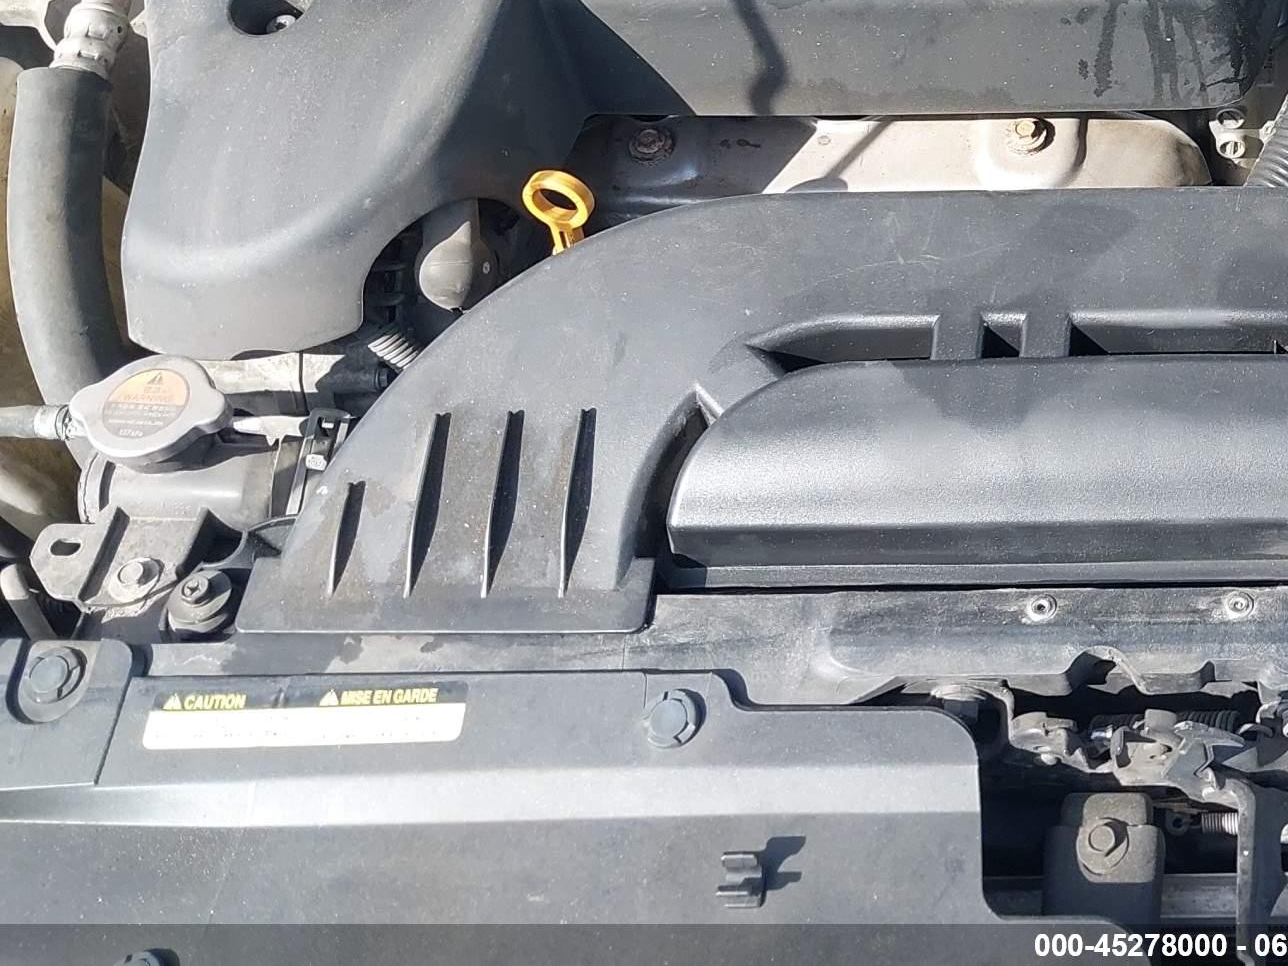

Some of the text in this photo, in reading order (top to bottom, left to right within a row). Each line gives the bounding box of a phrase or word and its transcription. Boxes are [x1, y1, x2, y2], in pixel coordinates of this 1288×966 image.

[183, 693, 247, 710] CAUTION
[340, 687, 440, 706] MISE EN GARDE
